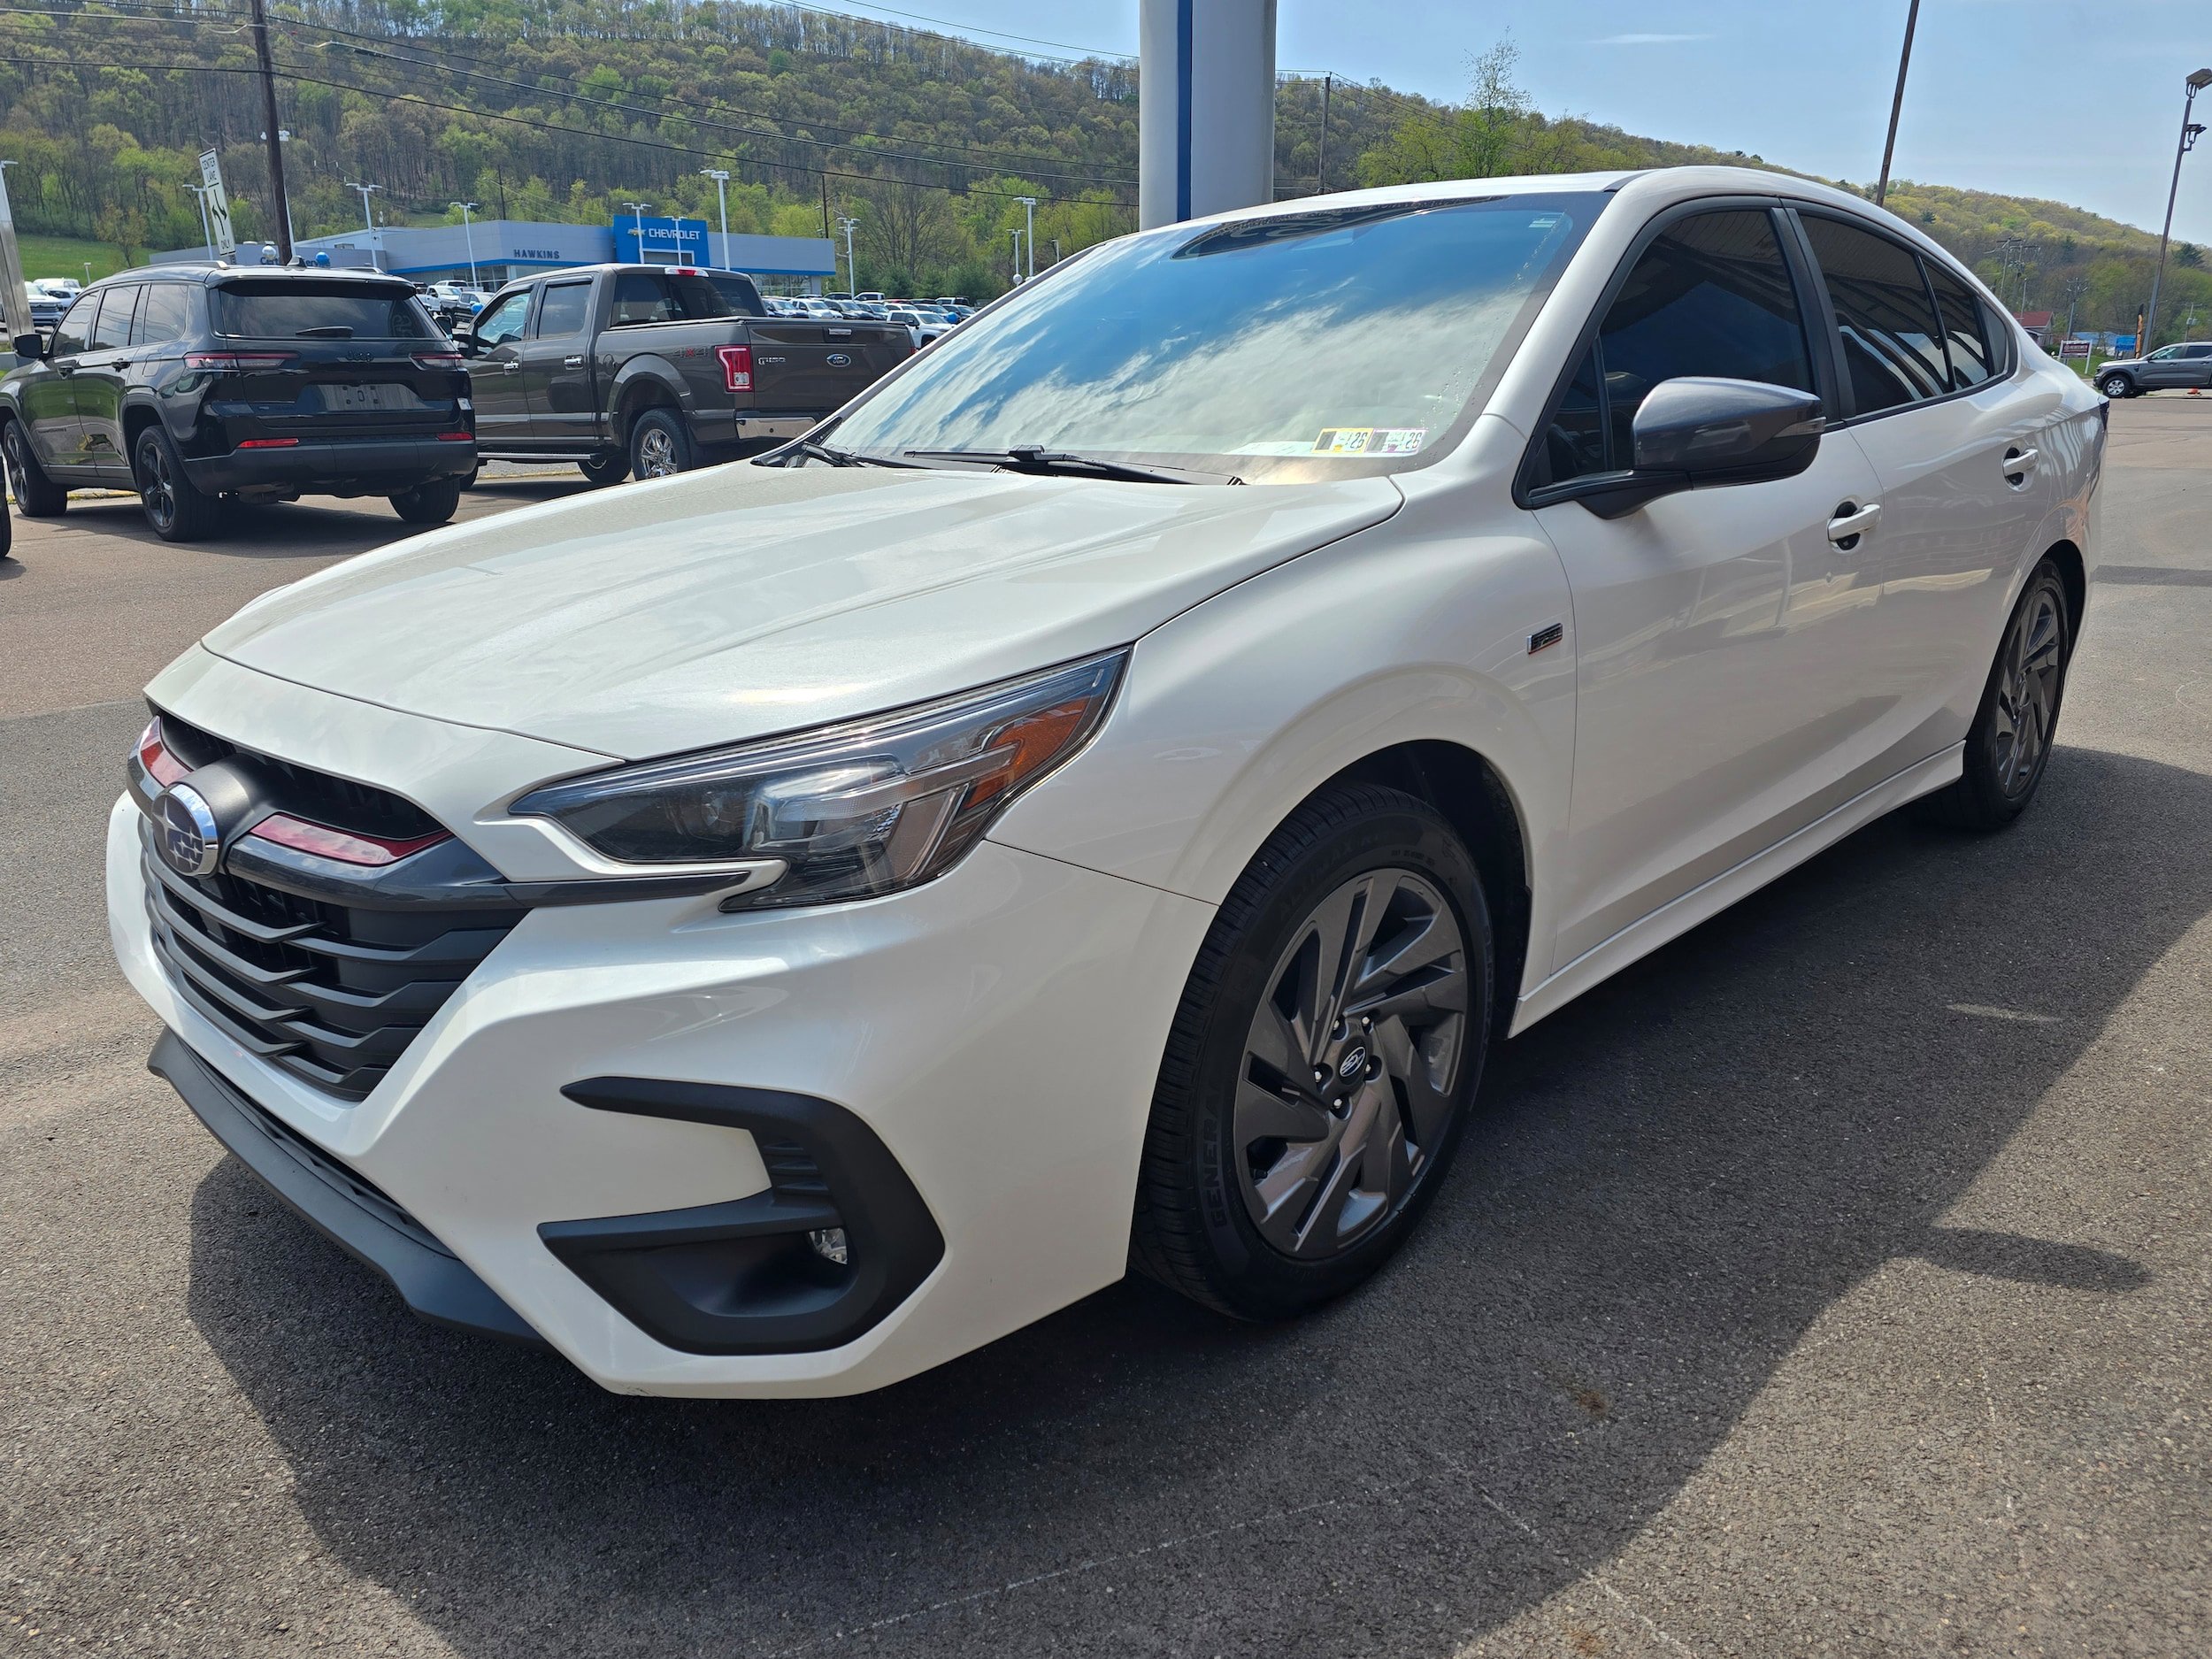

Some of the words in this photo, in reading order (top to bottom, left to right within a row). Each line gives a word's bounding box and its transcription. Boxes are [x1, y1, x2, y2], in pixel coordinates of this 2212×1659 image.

[203, 157, 215, 170] CENTER
[206, 171, 217, 182] LANE
[649, 228, 700, 240] CHEVROLET
[220, 239, 230, 250] ONLY
[514, 249, 560, 259] HAWKINS
